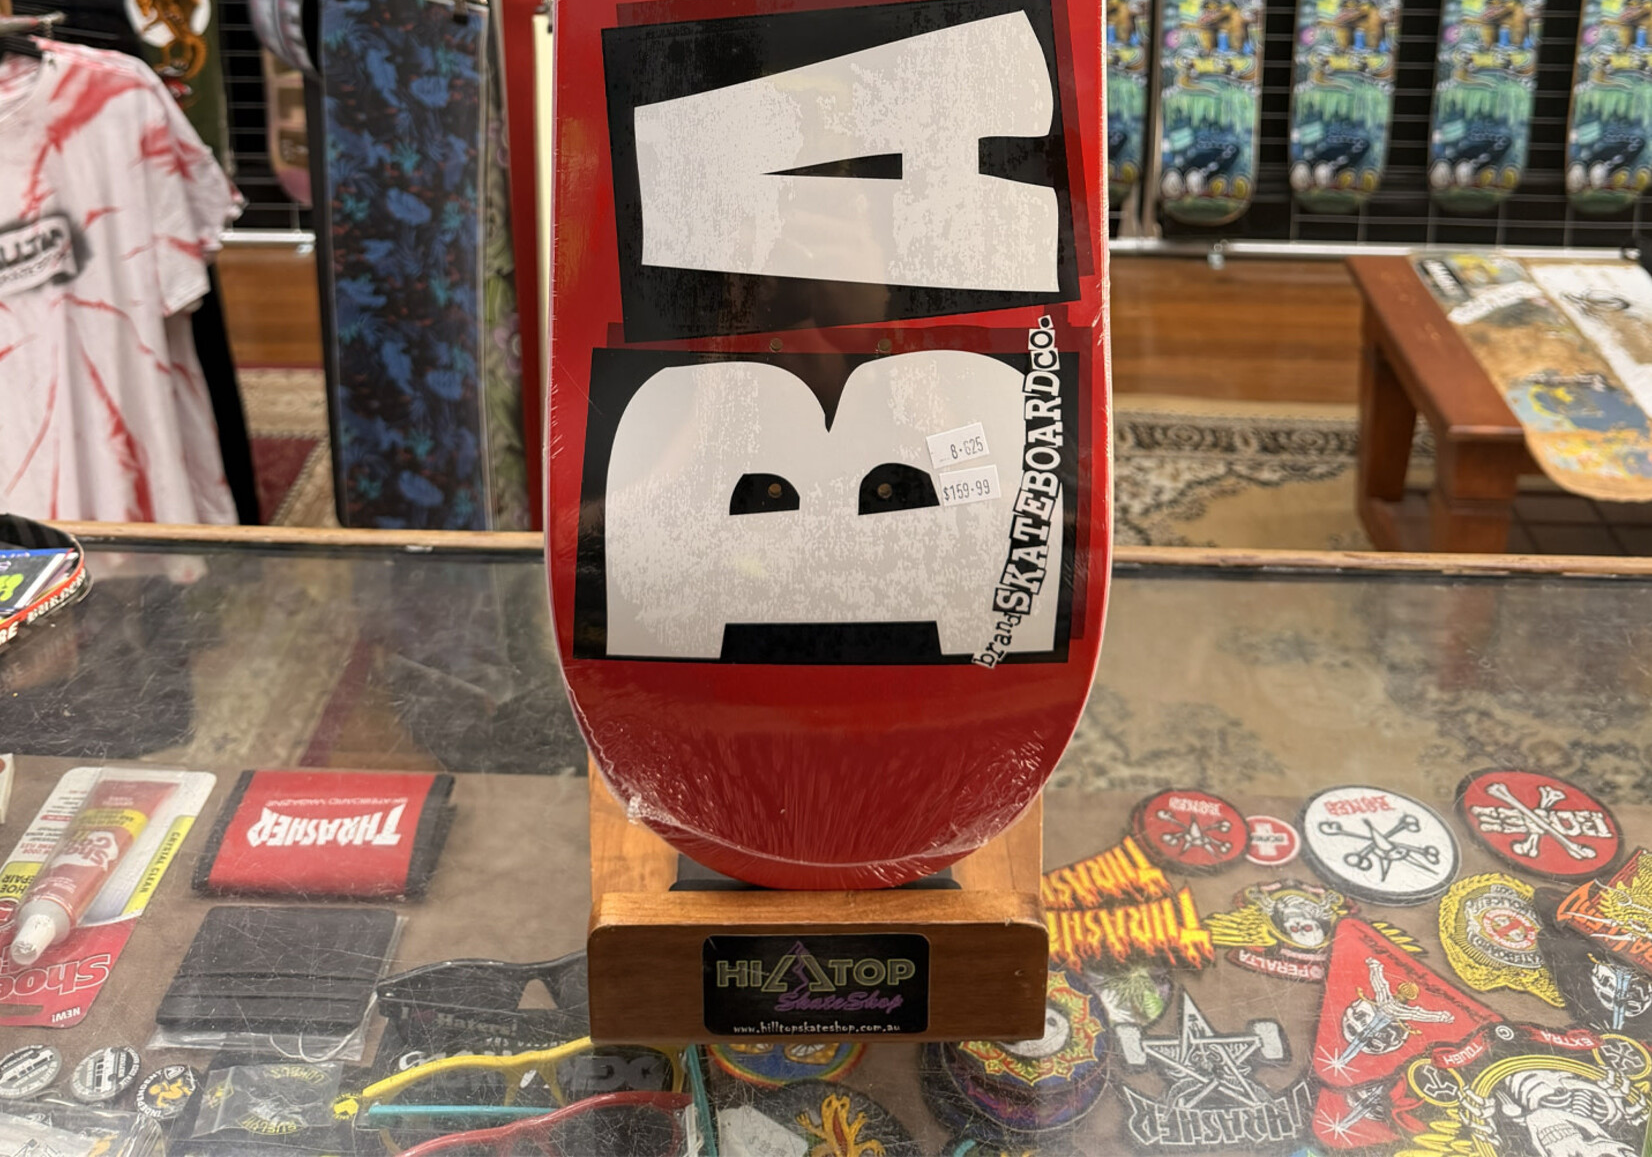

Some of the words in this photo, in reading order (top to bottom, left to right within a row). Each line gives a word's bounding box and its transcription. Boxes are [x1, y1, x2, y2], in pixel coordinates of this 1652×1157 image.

[992, 368, 1063, 615] SKATEBOARD
[972, 612, 1023, 669] brand
[246, 802, 407, 848] THRASHER
[0, 883, 28, 895] HOE
[1, 874, 35, 885] EPAIR
[1238, 949, 1310, 978] PERALTA
[51, 1006, 81, 1024] NEW!
[733, 1020, 901, 1035] www.hilltopskateshop.com.au
[1541, 1031, 1593, 1048] EXTRA
[1443, 1042, 1483, 1066] TOUGH
[1123, 1081, 1312, 1145] THRASHER
